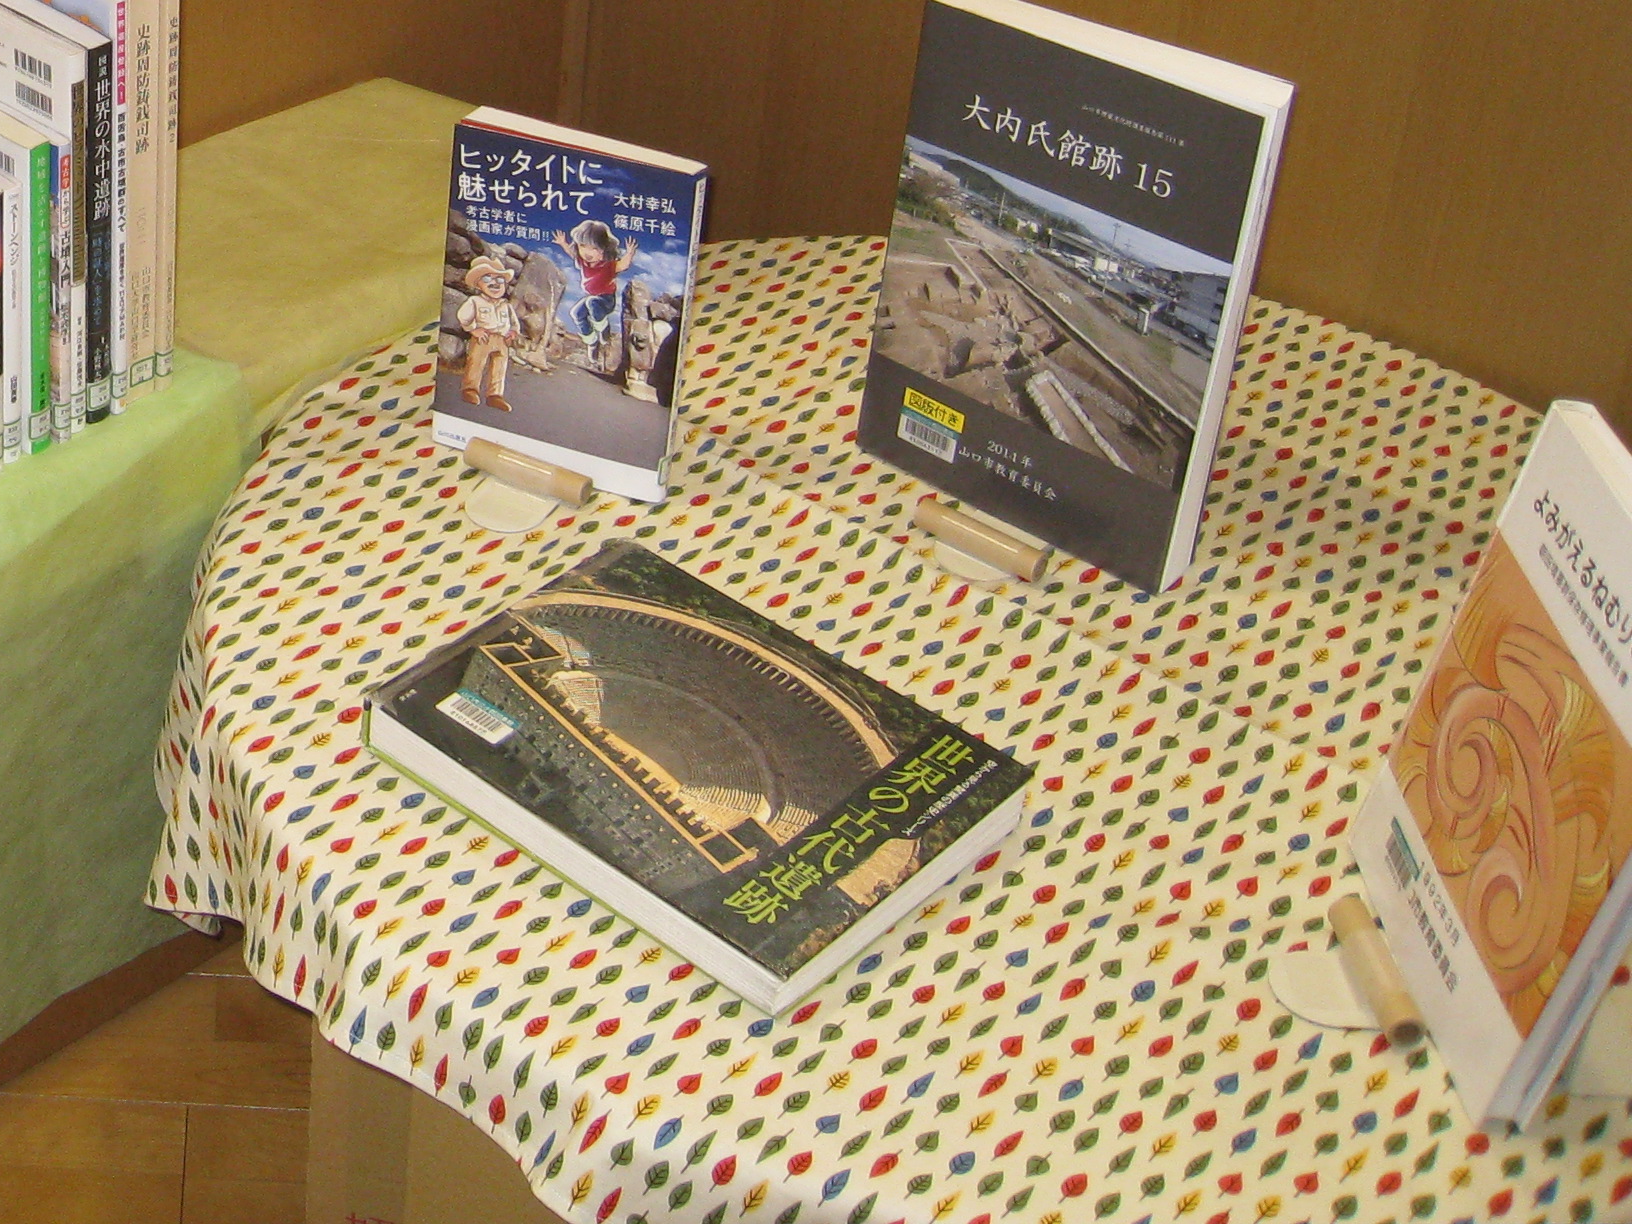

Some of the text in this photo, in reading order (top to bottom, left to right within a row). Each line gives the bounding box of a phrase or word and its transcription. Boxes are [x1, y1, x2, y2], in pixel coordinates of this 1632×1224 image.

[93, 78, 112, 223] 世界の水中遺跡
[459, 143, 603, 186] ヒッタイトに
[965, 93, 1174, 200] 大内氏館跡 15
[458, 171, 595, 216] 魅せられて
[466, 205, 528, 225] 考古学者に
[613, 191, 677, 216] 大村幸弘
[909, 391, 959, 427] 図版付き
[723, 734, 975, 924] 世界の古代遺跡
